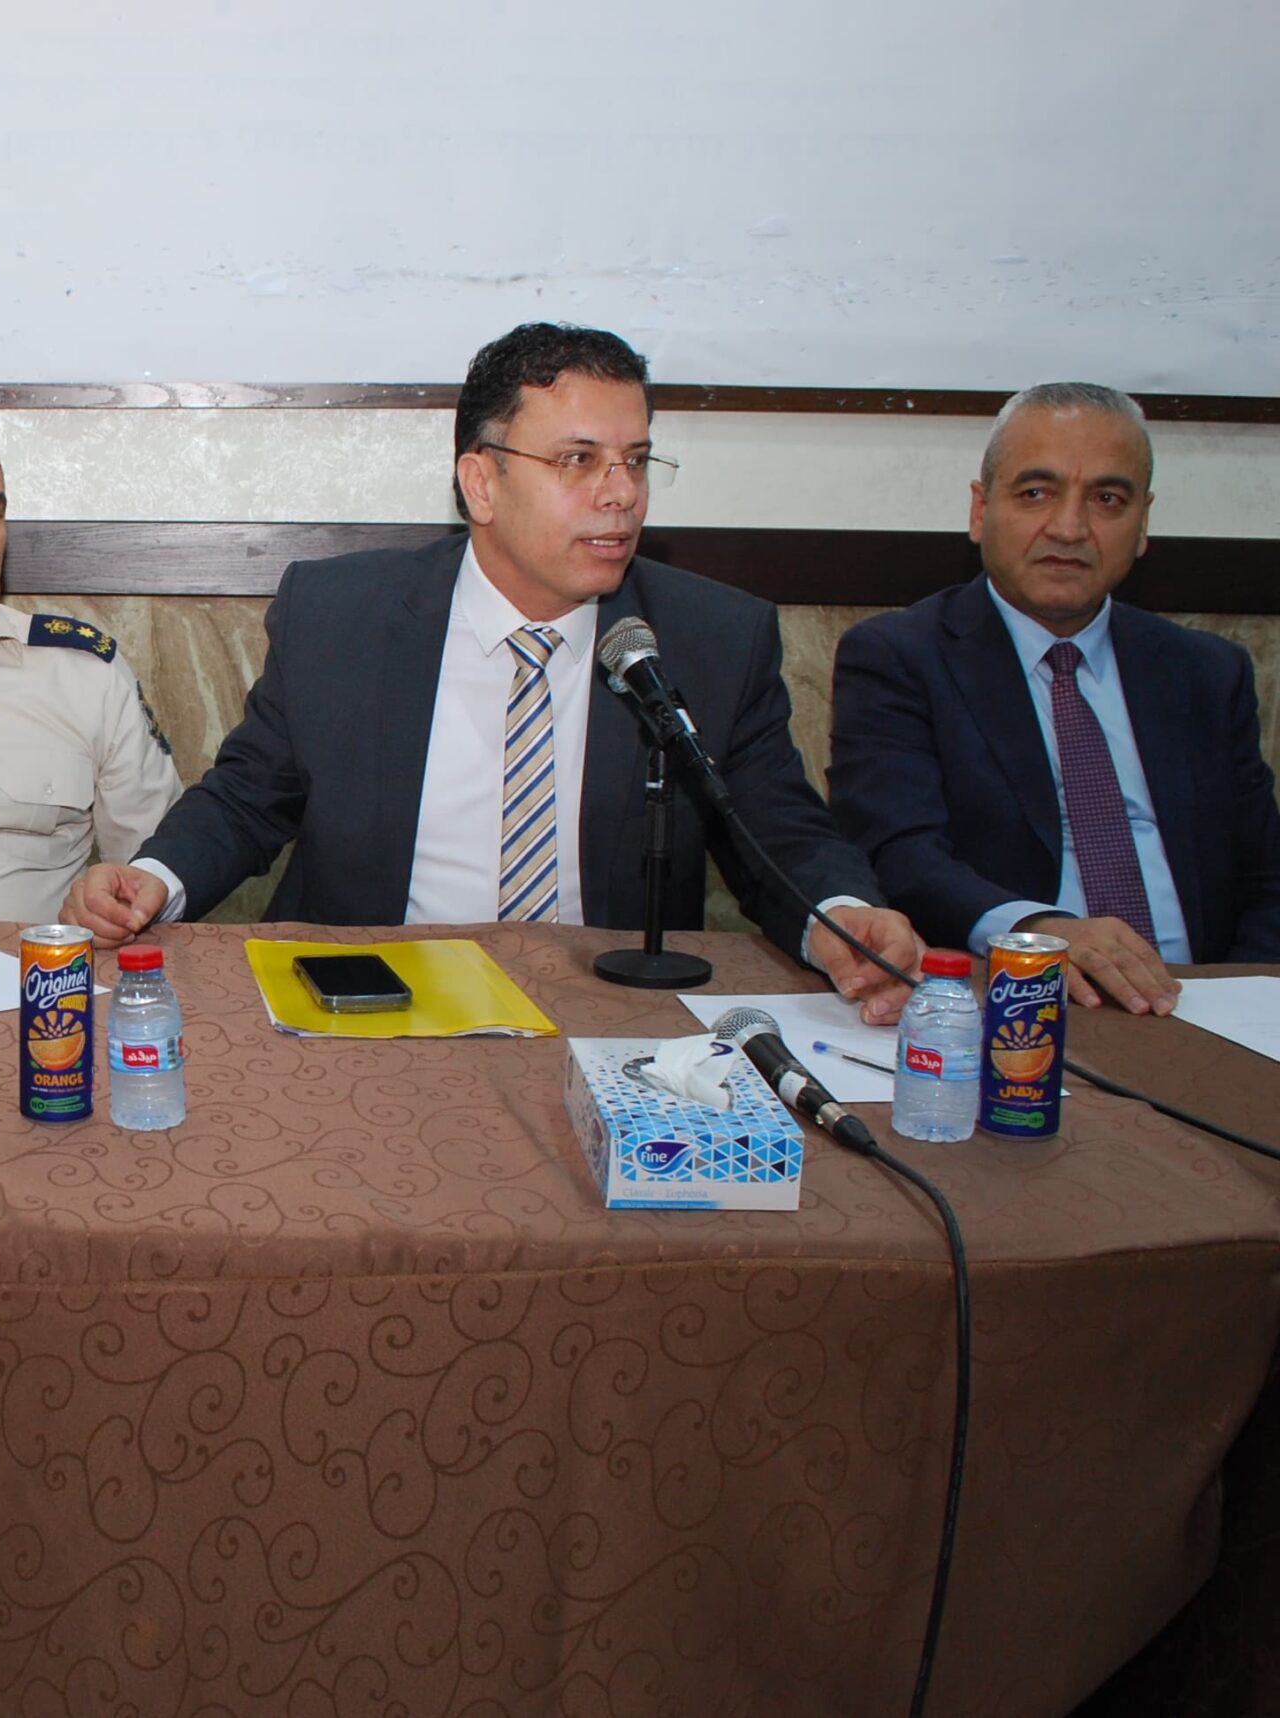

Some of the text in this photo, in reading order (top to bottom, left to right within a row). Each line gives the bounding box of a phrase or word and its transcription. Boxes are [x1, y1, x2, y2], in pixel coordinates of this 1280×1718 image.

[26, 966, 88, 1009] Original
[34, 1071, 84, 1087] ORANGE
[640, 1145, 668, 1163] fine
